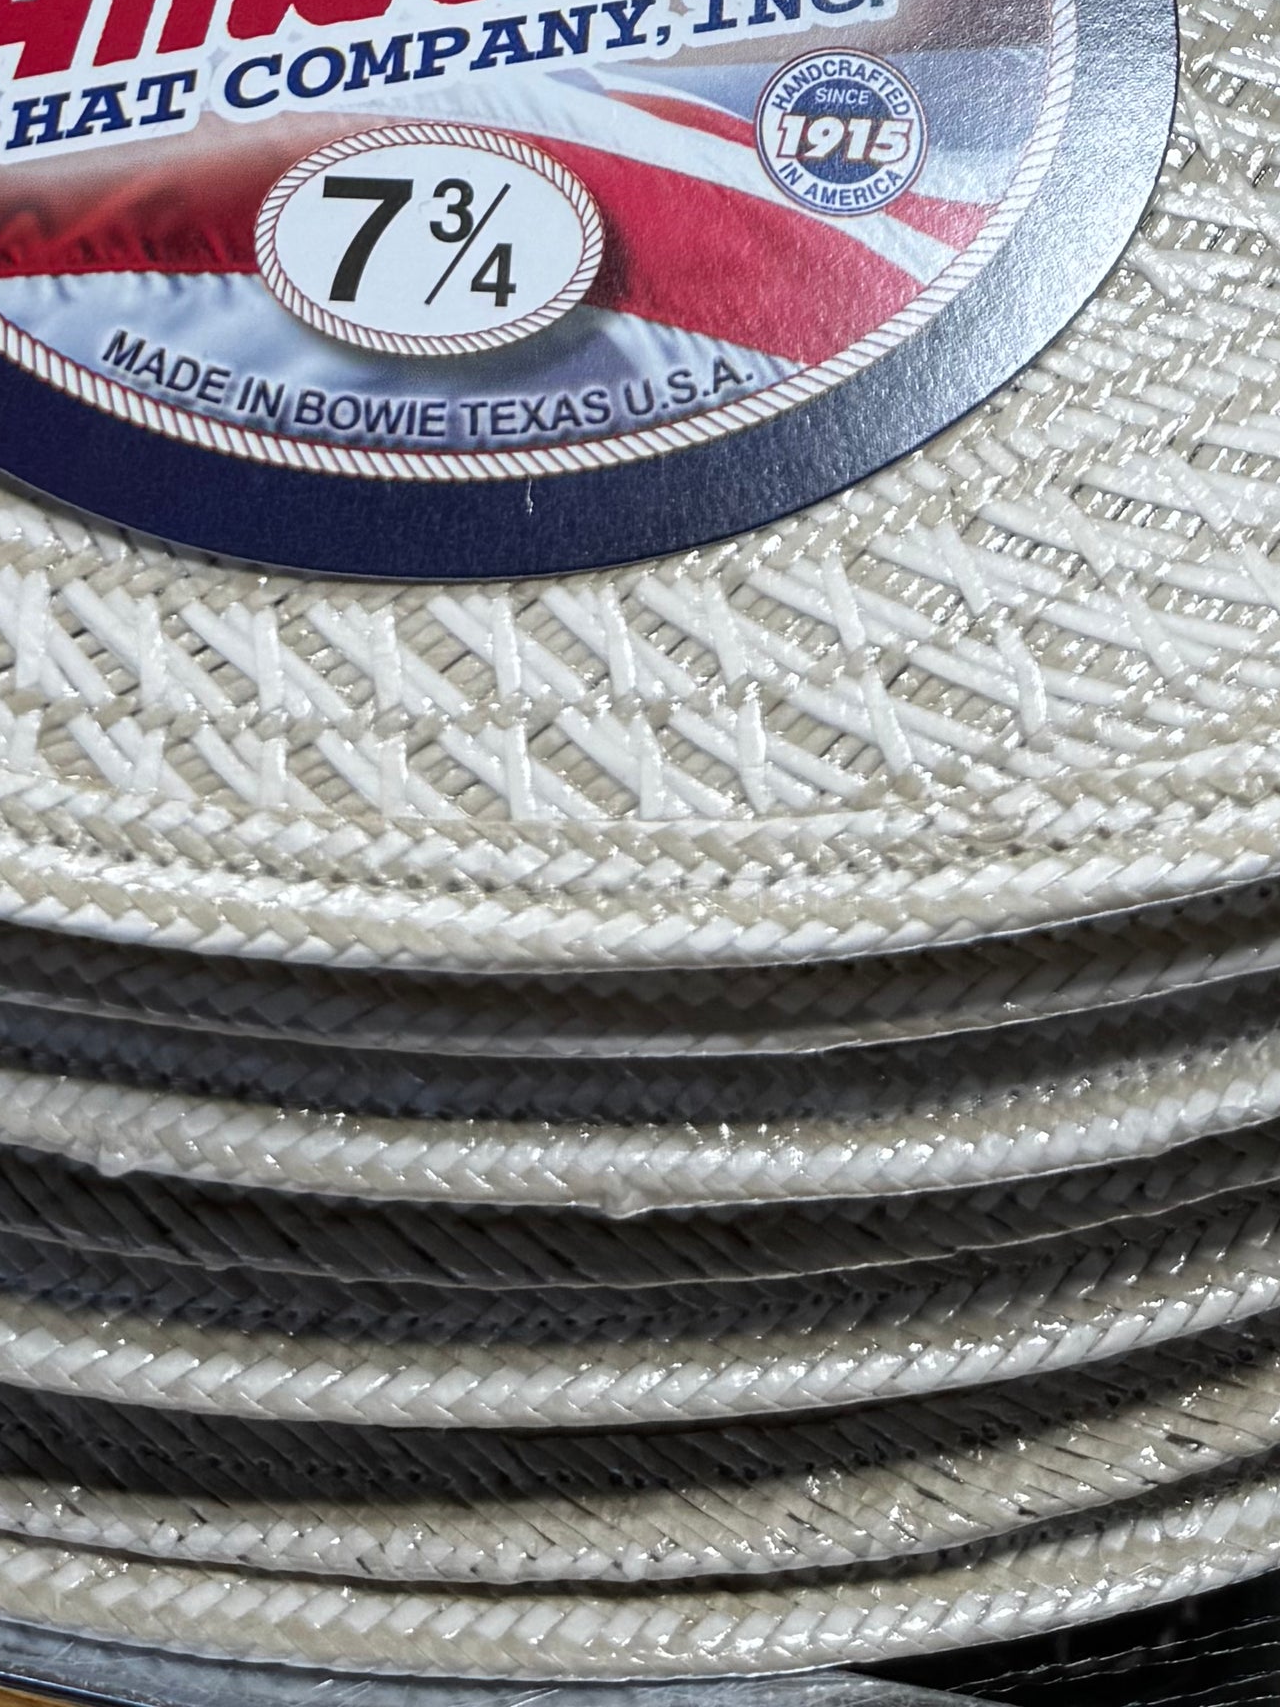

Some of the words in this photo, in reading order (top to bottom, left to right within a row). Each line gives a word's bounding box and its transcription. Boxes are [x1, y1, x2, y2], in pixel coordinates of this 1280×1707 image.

[4, 69, 199, 151] HAT
[771, 59, 911, 116] HANDCRAFTED
[814, 86, 870, 105] SINCE
[775, 112, 914, 164] 1915
[778, 161, 804, 186] IN
[803, 169, 905, 207] AMERICA
[322, 175, 415, 303] 7
[101, 329, 232, 404] MADE
[236, 375, 286, 419] IN
[293, 389, 447, 438] BOWIE
[460, 388, 612, 437] TEXAS
[624, 355, 755, 417] U.S.A.
